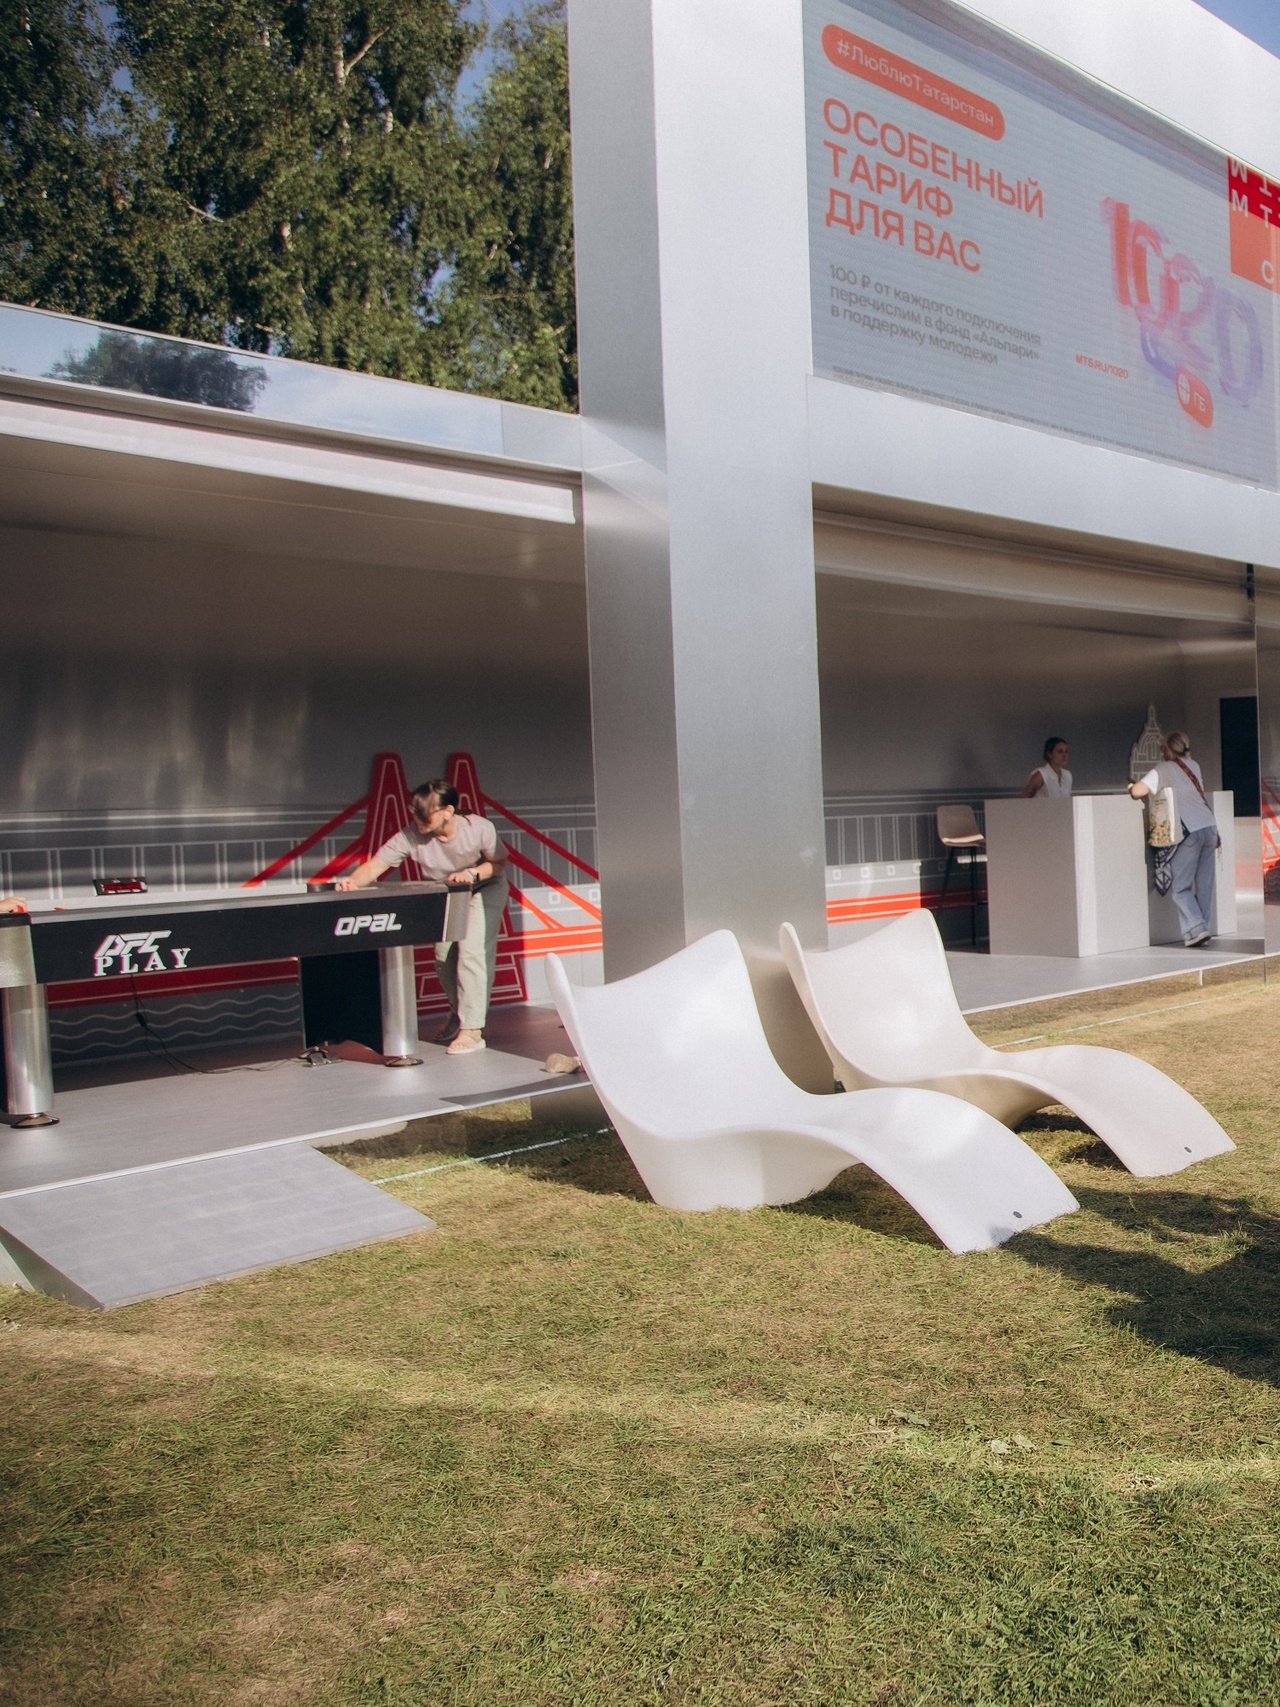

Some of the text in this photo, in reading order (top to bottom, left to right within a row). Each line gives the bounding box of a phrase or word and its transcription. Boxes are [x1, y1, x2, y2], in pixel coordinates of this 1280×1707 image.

[836, 38, 994, 127] #ЛюблюТатарстан
[823, 98, 1043, 219] ОСОБЕННЫЙ
[823, 139, 953, 217] ТАРИФ
[825, 187, 981, 272] ДЛЯ ВАС
[830, 264, 857, 285] 100
[874, 282, 892, 297] от
[894, 287, 954, 318] каждого
[956, 308, 1042, 346] подключения
[830, 286, 1040, 361] перечислим в фонд «Альпари»
[831, 304, 998, 365] в поддержку молодежи
[94, 947, 191, 977] PLAY
